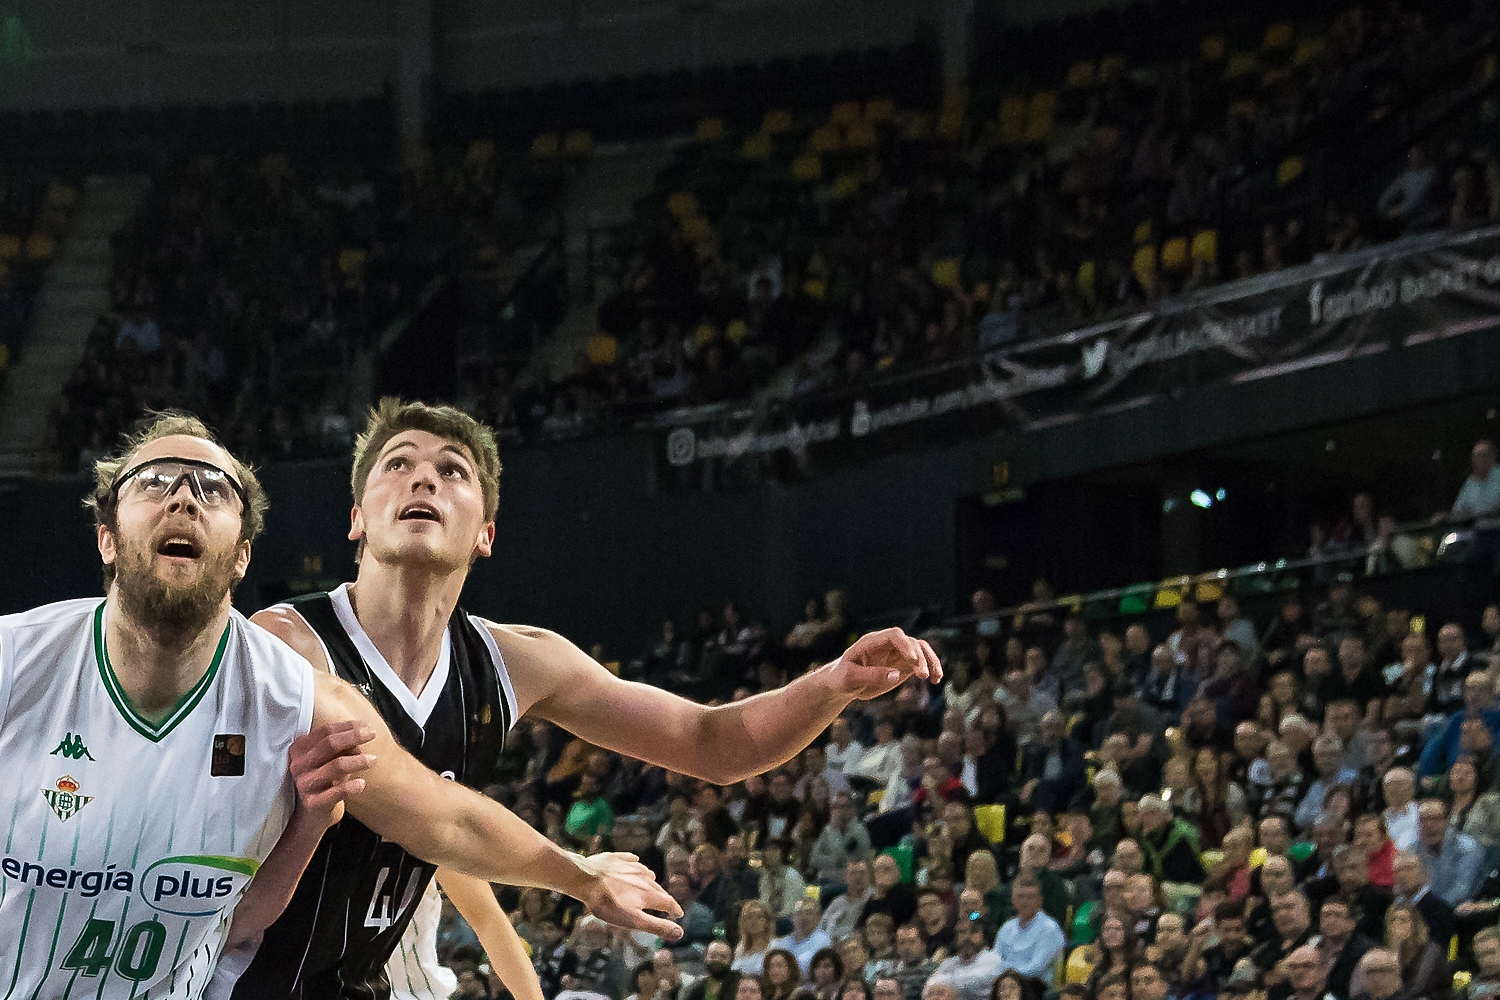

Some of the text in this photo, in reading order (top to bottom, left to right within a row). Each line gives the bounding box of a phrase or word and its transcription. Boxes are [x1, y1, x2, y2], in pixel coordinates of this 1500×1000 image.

[1, 856, 234, 902] energía plus
[61, 917, 167, 982] 40
